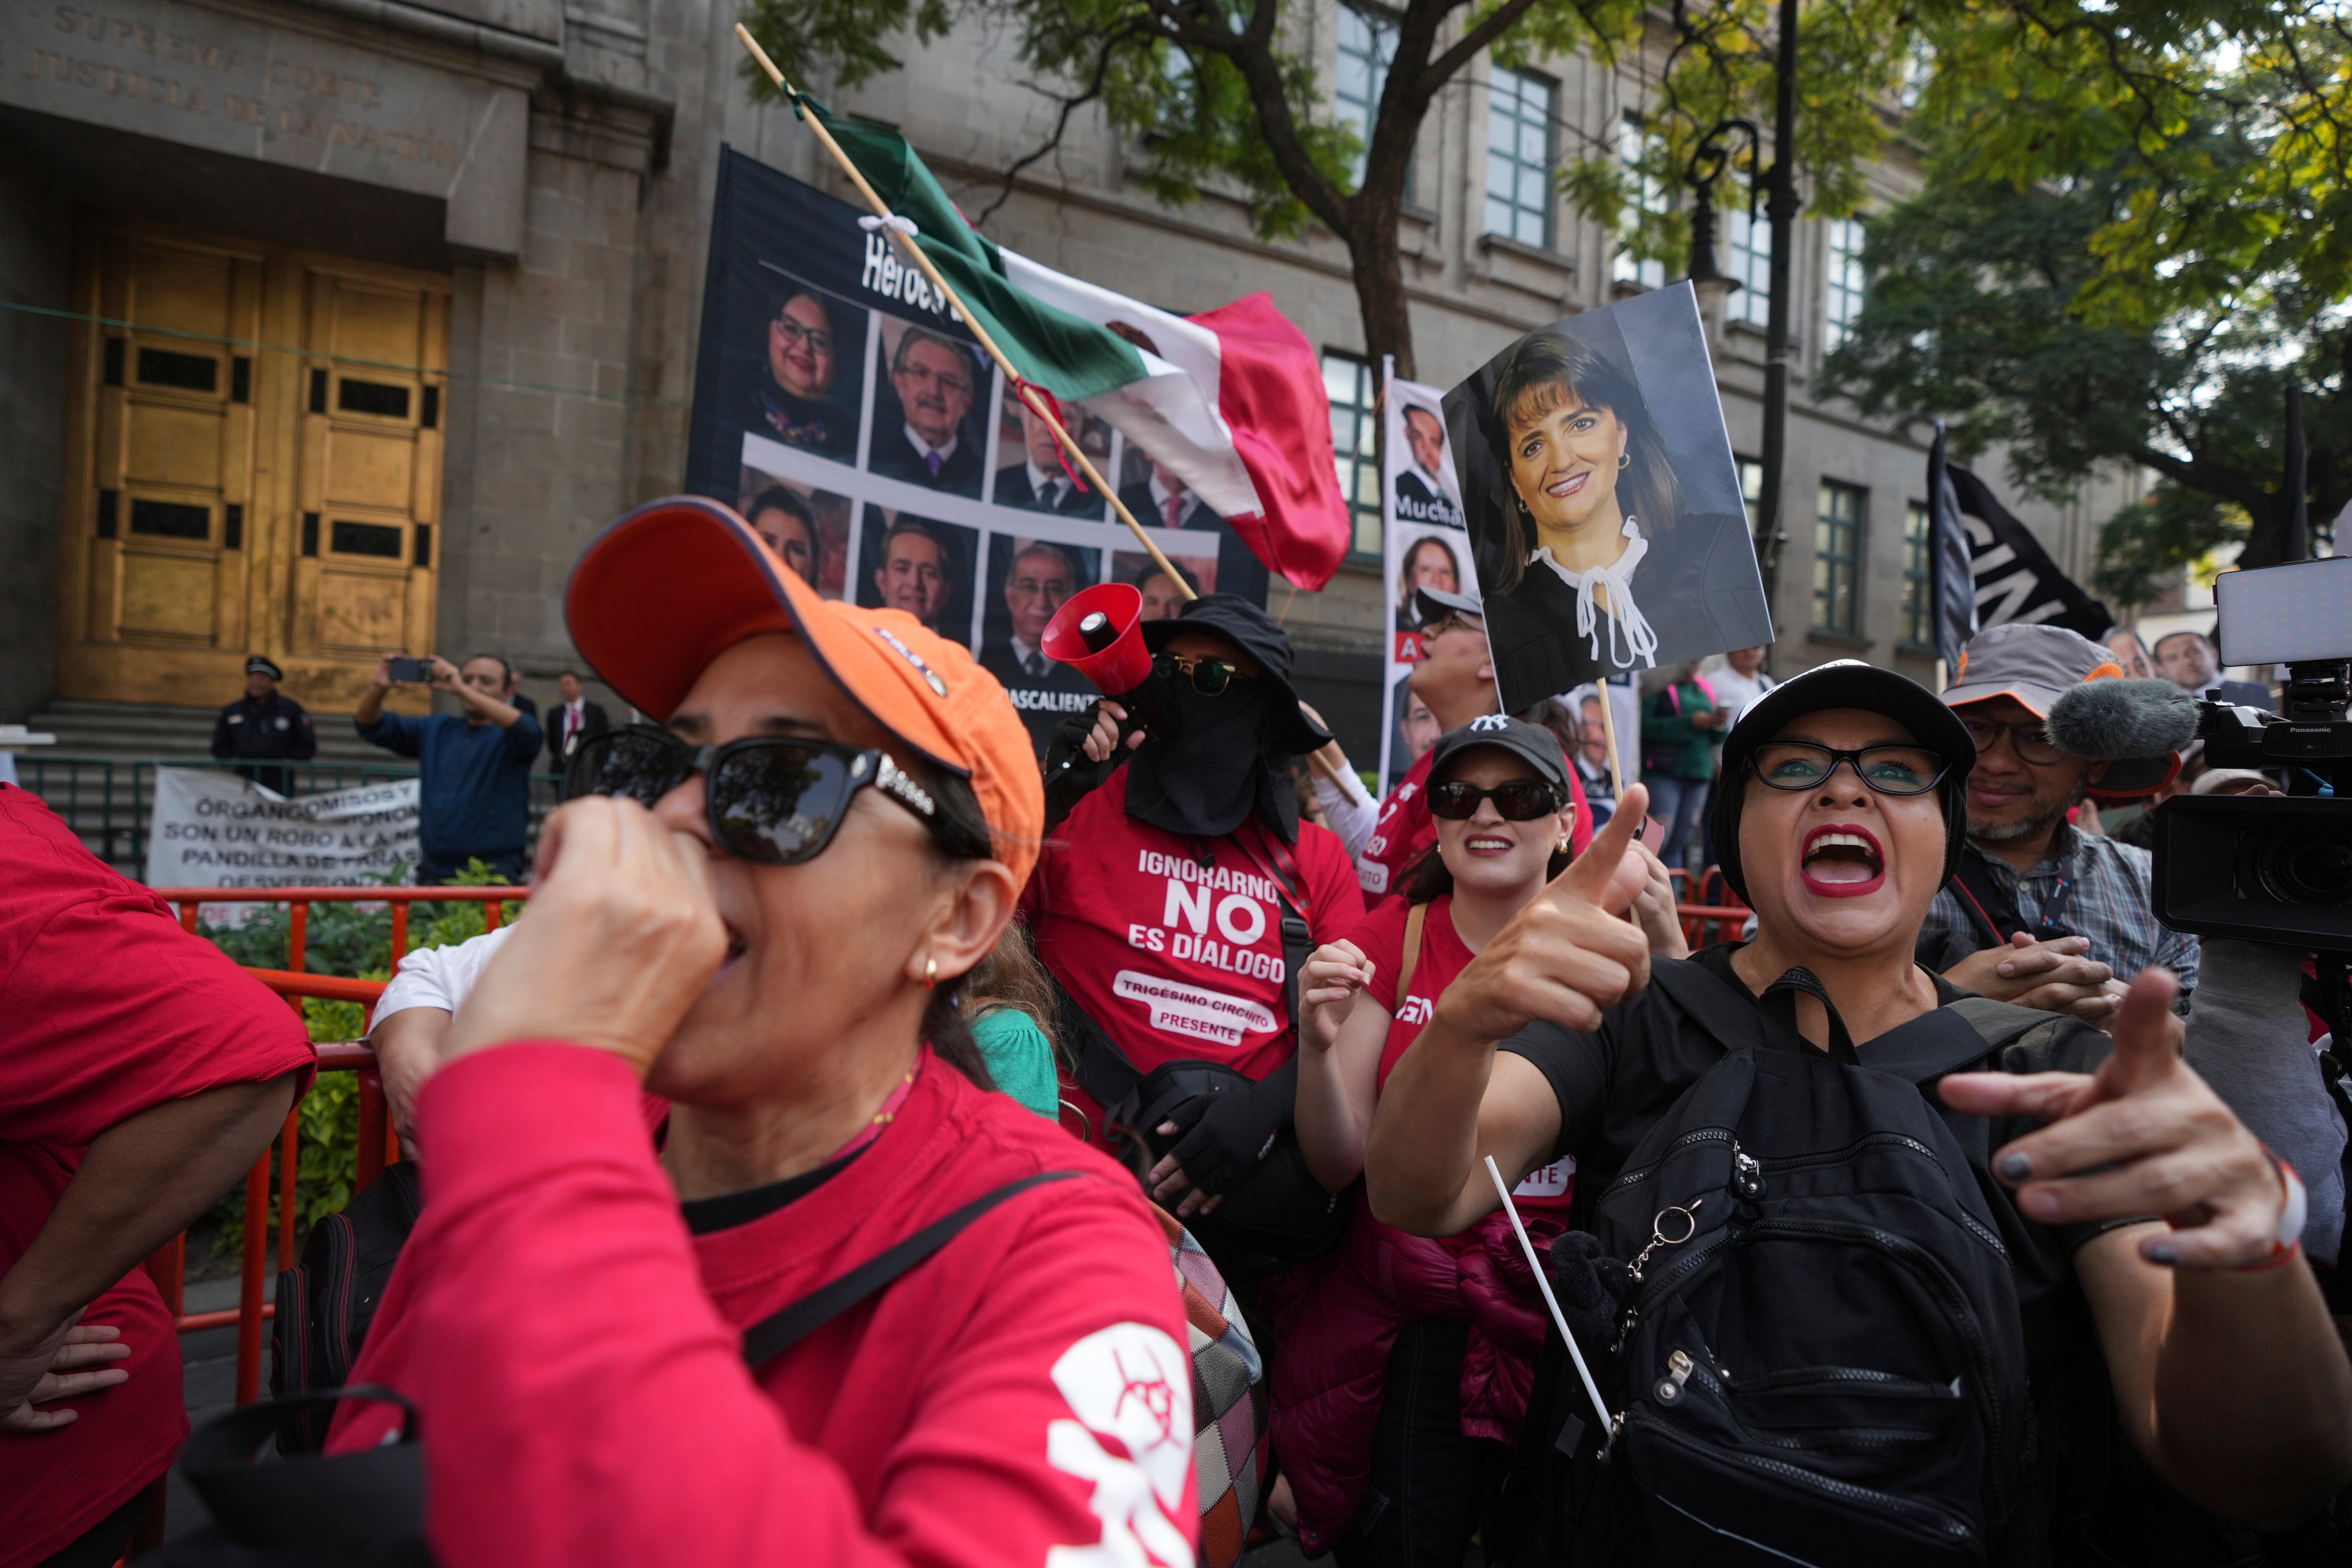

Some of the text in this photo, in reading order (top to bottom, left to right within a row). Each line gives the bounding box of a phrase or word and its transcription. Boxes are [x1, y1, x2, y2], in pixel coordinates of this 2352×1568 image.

[55, 5, 383, 110] SUPREMA CORTE
[25, 49, 211, 116] JUSTICIA
[225, 93, 267, 127] DE
[278, 108, 321, 139] LA
[1004, 688, 1104, 713] ASCALIENT
[164, 821, 218, 842] SON
[225, 826, 258, 843] UN
[266, 827, 333, 847] ROBO
[182, 848, 299, 869] PANDILLA
[1163, 878, 1266, 945] NO
[1128, 923, 1165, 951] ES
[1123, 980, 1268, 1027] TRIGÉSIMO CIRCUITO
[1159, 1012, 1237, 1041] PRESENTE
